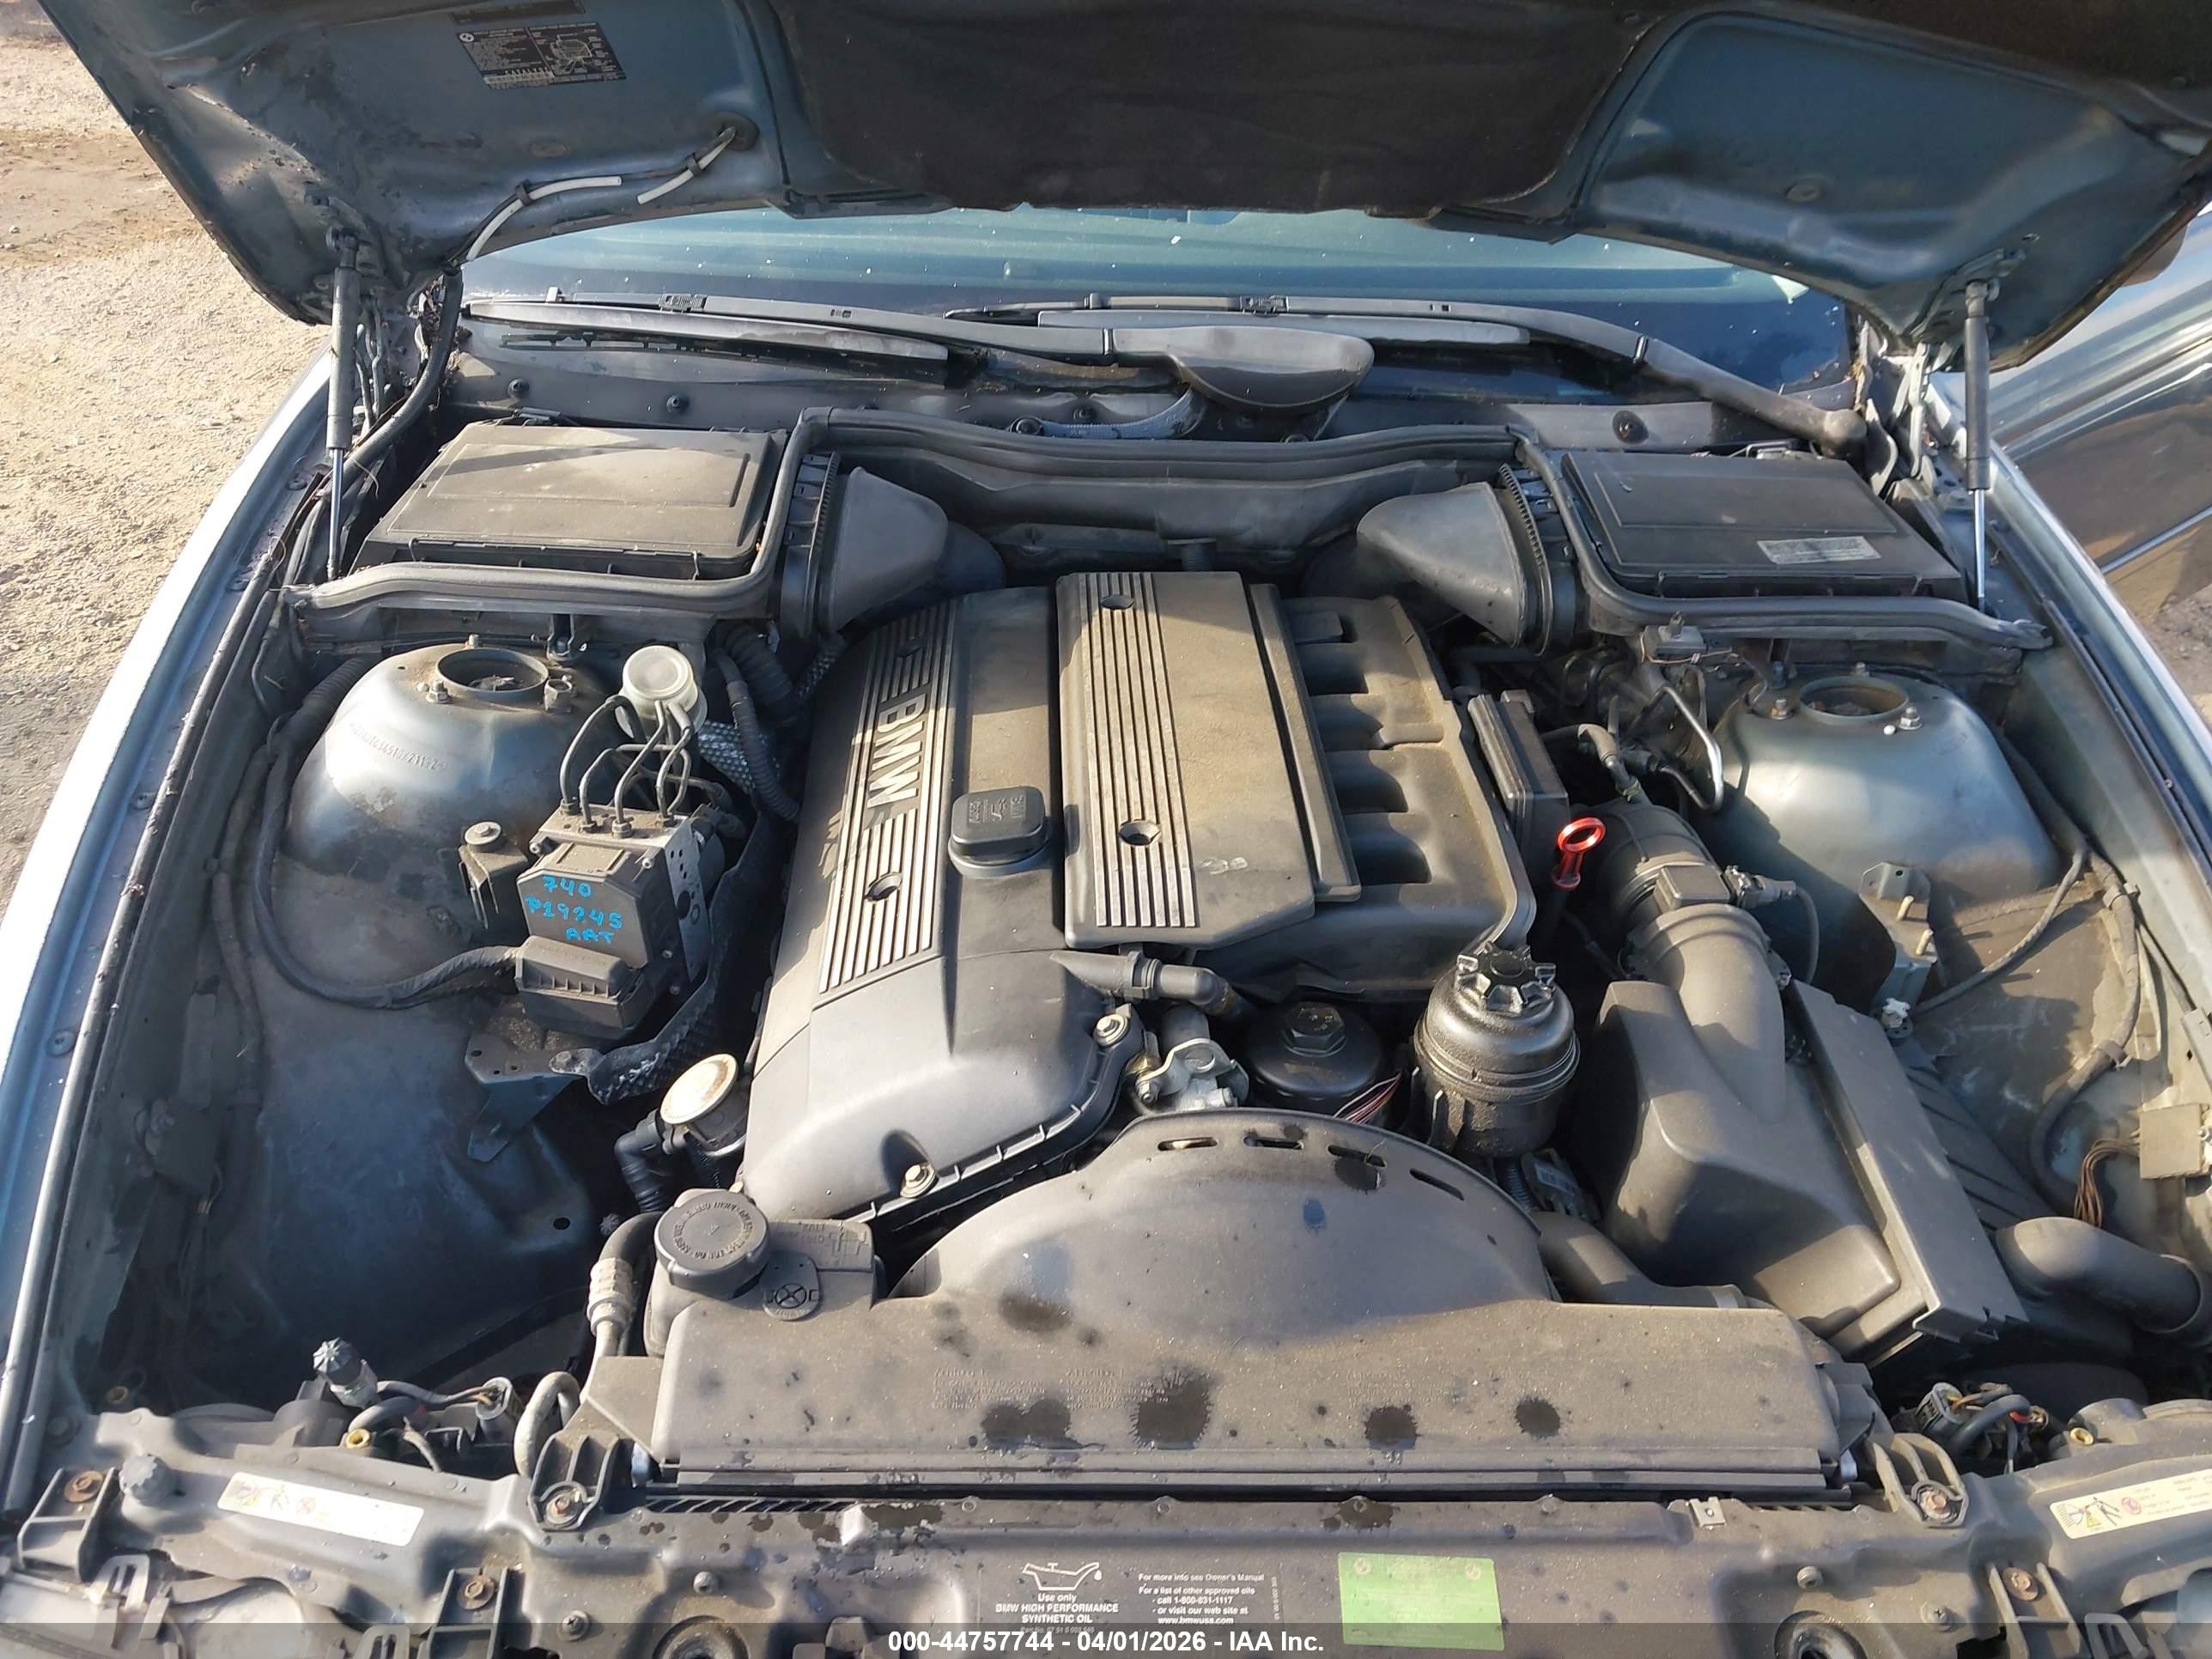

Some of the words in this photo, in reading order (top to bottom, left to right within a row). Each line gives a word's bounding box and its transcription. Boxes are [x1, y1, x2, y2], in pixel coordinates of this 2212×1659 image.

[866, 693, 928, 810] BMW
[1237, 1573, 1265, 1582] Manual
[1204, 1587, 1240, 1596] approved
[1037, 1593, 1055, 1602] Use
[1057, 1593, 1077, 1604] only
[995, 1603, 1019, 1613] BMW
[1021, 1603, 1045, 1613] HIGH
[1047, 1603, 1119, 1613] PERFORMANCE
[1169, 1606, 1187, 1614] visit
[1204, 1606, 1221, 1614] web
[1223, 1606, 1237, 1614] site
[1022, 1613, 1075, 1623] SYNTHETIC
[1076, 1613, 1093, 1623] OIL
